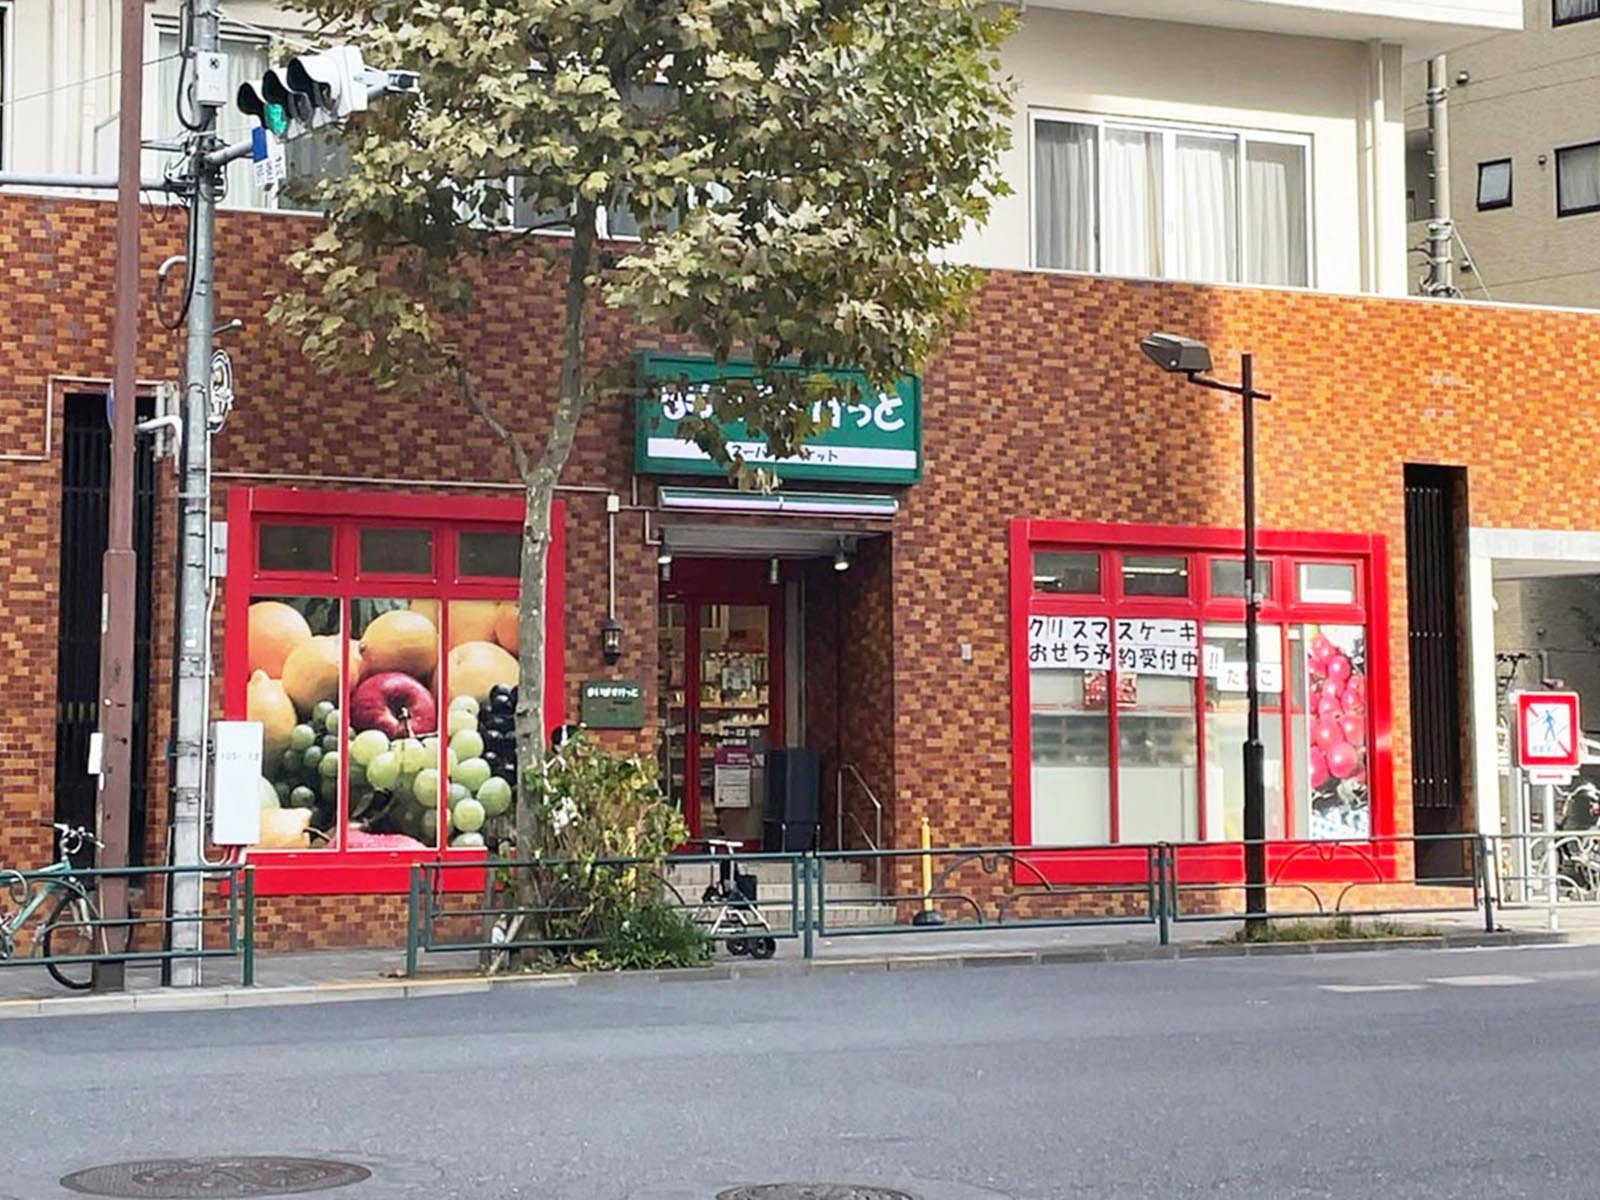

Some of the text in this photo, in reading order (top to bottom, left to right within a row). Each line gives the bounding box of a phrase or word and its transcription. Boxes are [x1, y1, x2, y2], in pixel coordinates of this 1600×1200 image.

[1029, 618, 1196, 642] クリスマスケーキ
